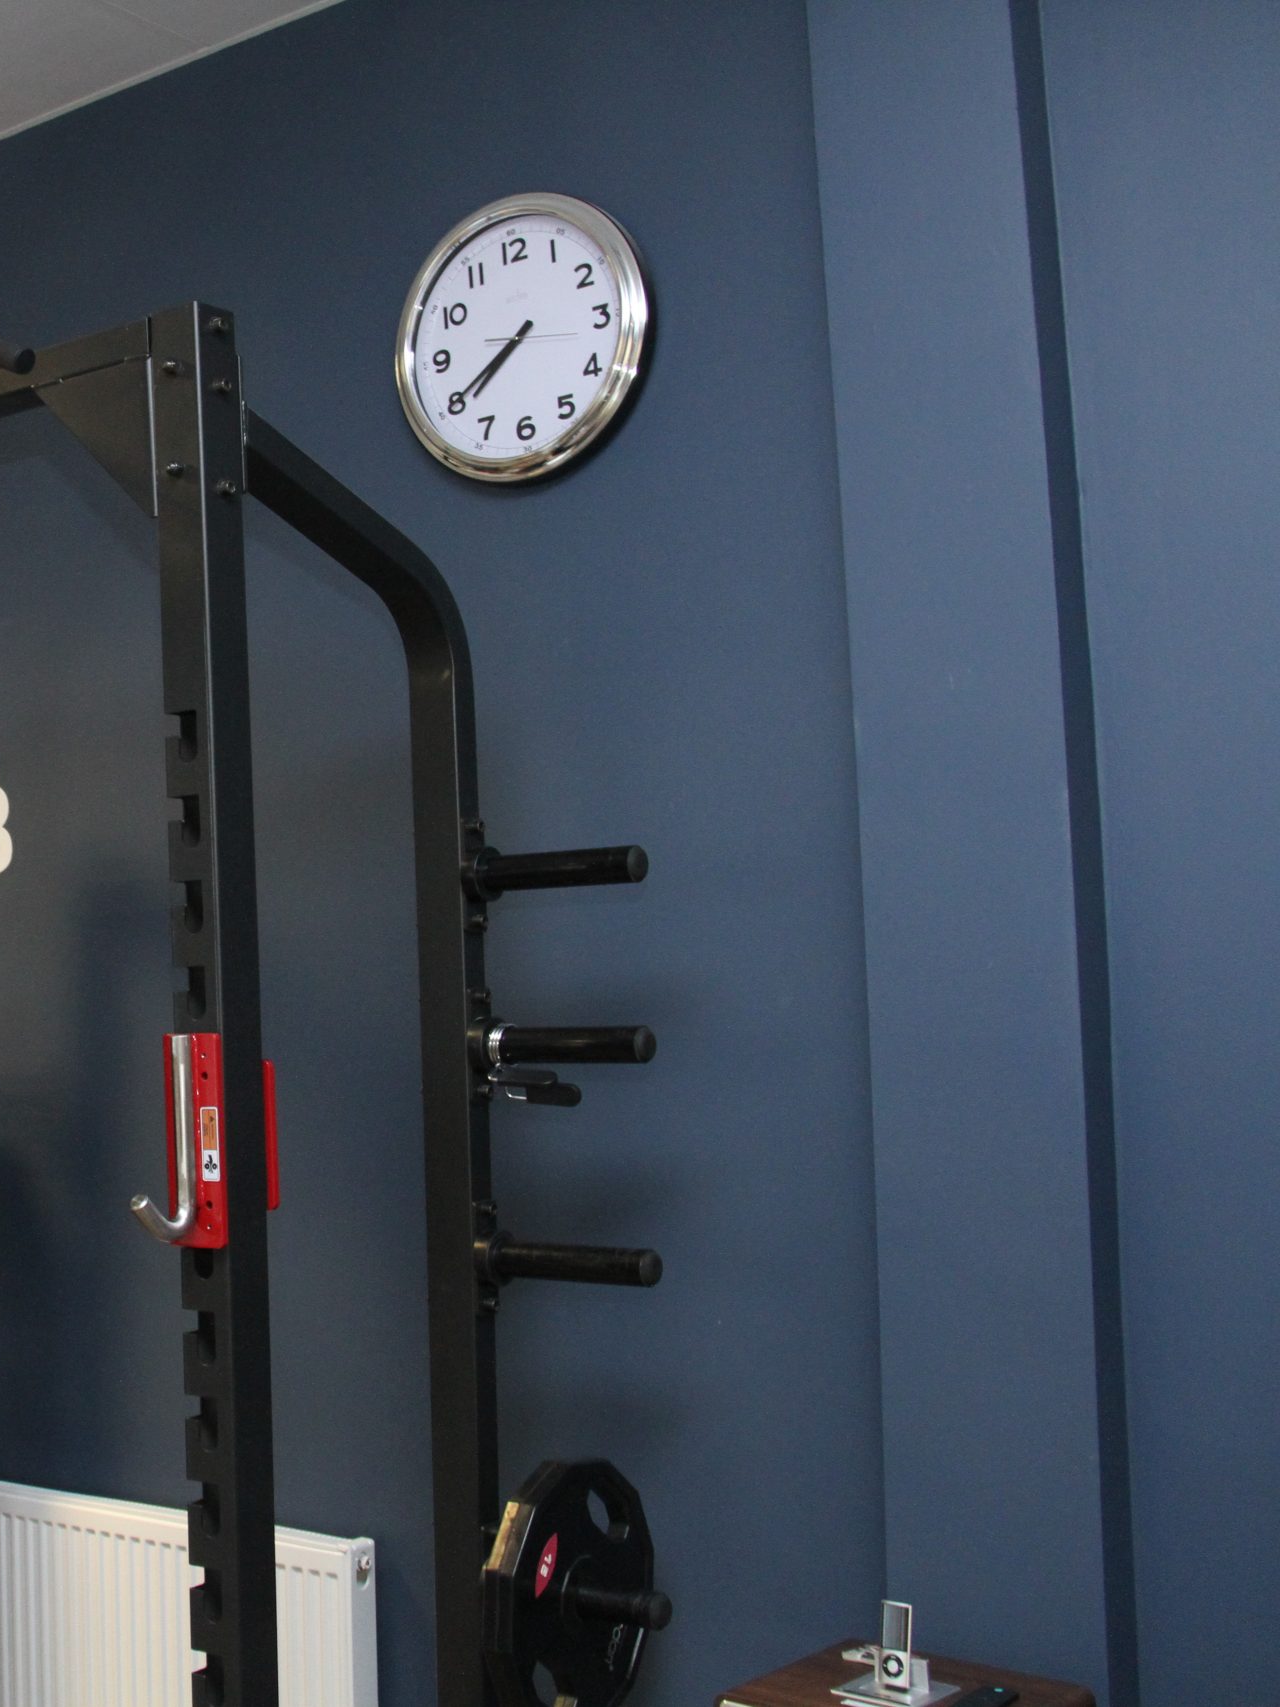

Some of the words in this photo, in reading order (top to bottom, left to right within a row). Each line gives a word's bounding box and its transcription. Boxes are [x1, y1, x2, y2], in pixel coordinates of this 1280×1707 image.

[501, 237, 528, 266] 12
[550, 239, 556, 263] 1
[468, 262, 484, 289] 11
[574, 263, 594, 289] 2
[443, 302, 468, 330] 10
[592, 302, 611, 329] 3
[433, 349, 451, 373] 9
[583, 352, 602, 377] 4
[447, 391, 466, 416] 8
[557, 393, 576, 420] 5
[477, 415, 495, 441] 7
[516, 415, 536, 441] 6
